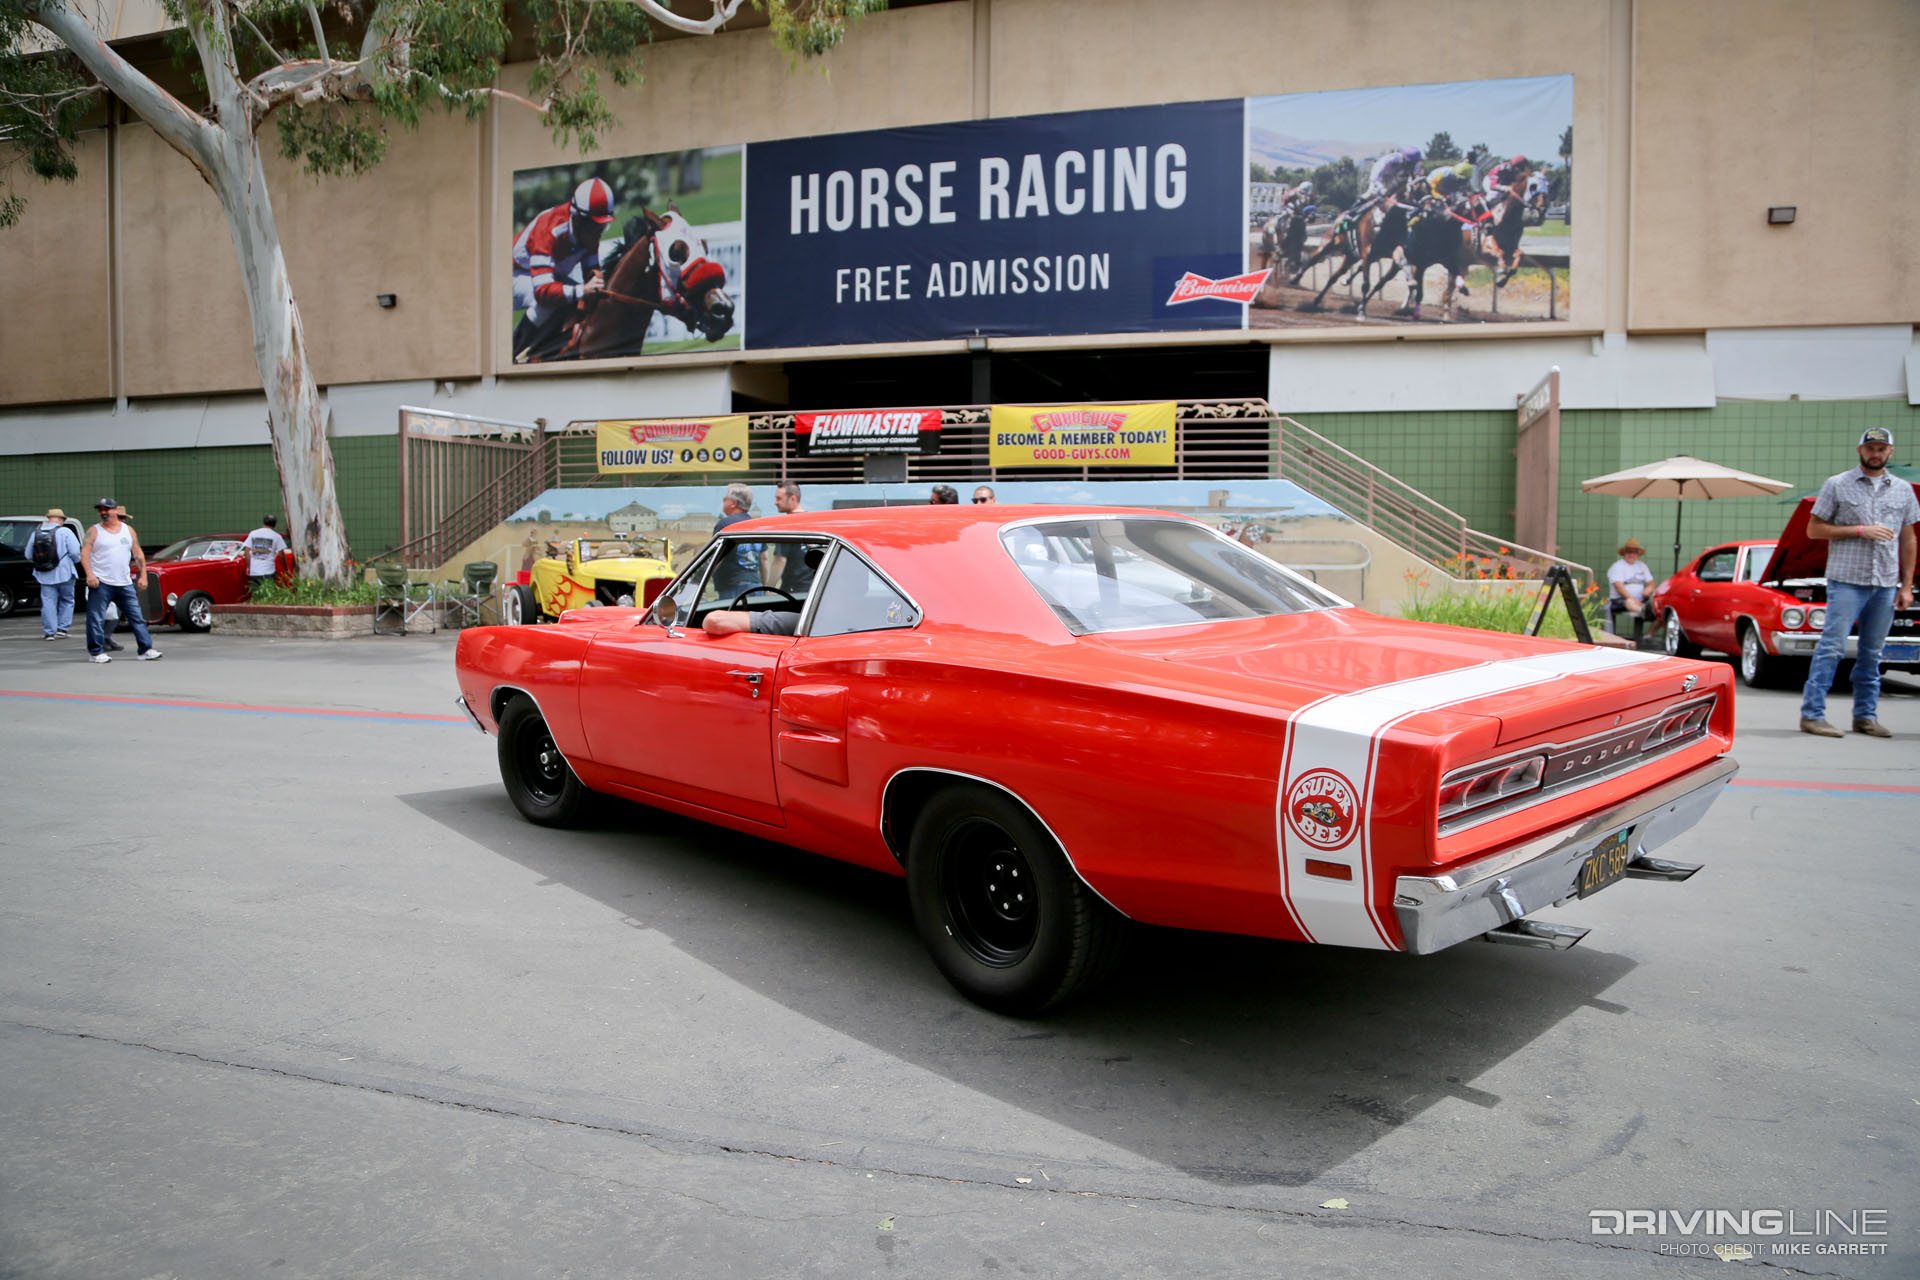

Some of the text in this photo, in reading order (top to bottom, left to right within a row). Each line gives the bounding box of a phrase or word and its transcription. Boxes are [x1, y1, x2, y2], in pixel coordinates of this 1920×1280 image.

[790, 143, 1188, 235] HORSE RACING
[836, 253, 1110, 303] FREE ADMISSION
[1175, 278, 1265, 298] Budweiser
[809, 413, 922, 446] FLOWMASTER
[997, 430, 1166, 446] BECOME A MEMBER TODAY!
[601, 449, 674, 466] FOLLOW US!
[1033, 448, 1130, 460] GOOD-GUYS.COM
[1563, 740, 1635, 772] DODGE
[1294, 777, 1351, 818] SUPER
[1297, 814, 1342, 843] BEE
[1584, 853, 1607, 890] ZKC
